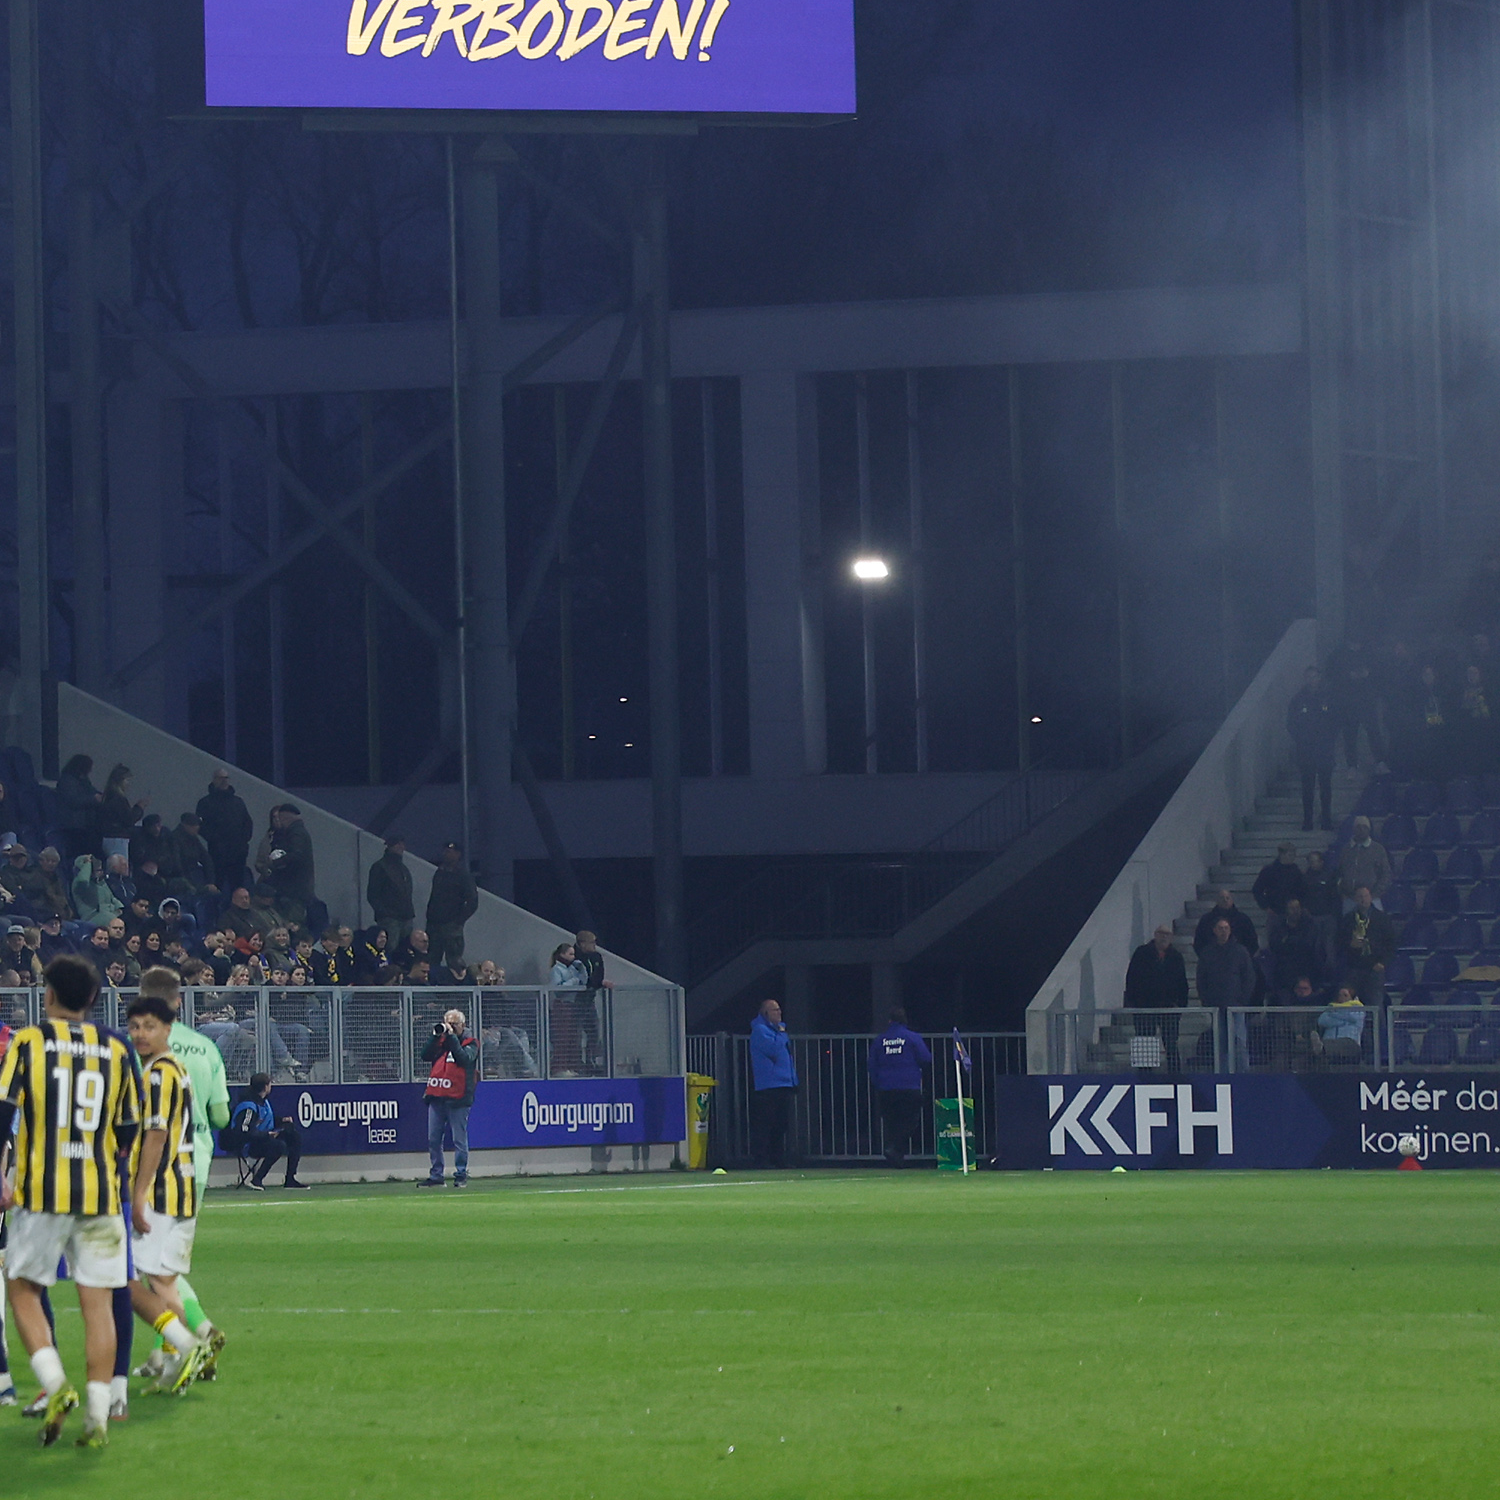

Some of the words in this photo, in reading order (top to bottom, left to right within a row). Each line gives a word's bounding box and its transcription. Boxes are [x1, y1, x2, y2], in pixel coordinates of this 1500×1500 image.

[882, 1038, 905, 1046] Security
[52, 1066, 105, 1132] 19
[299, 1091, 399, 1128] bourguignon
[521, 1090, 634, 1134] bourguignon
[1360, 1079, 1448, 1111] Méér
[368, 1125, 397, 1145] lease
